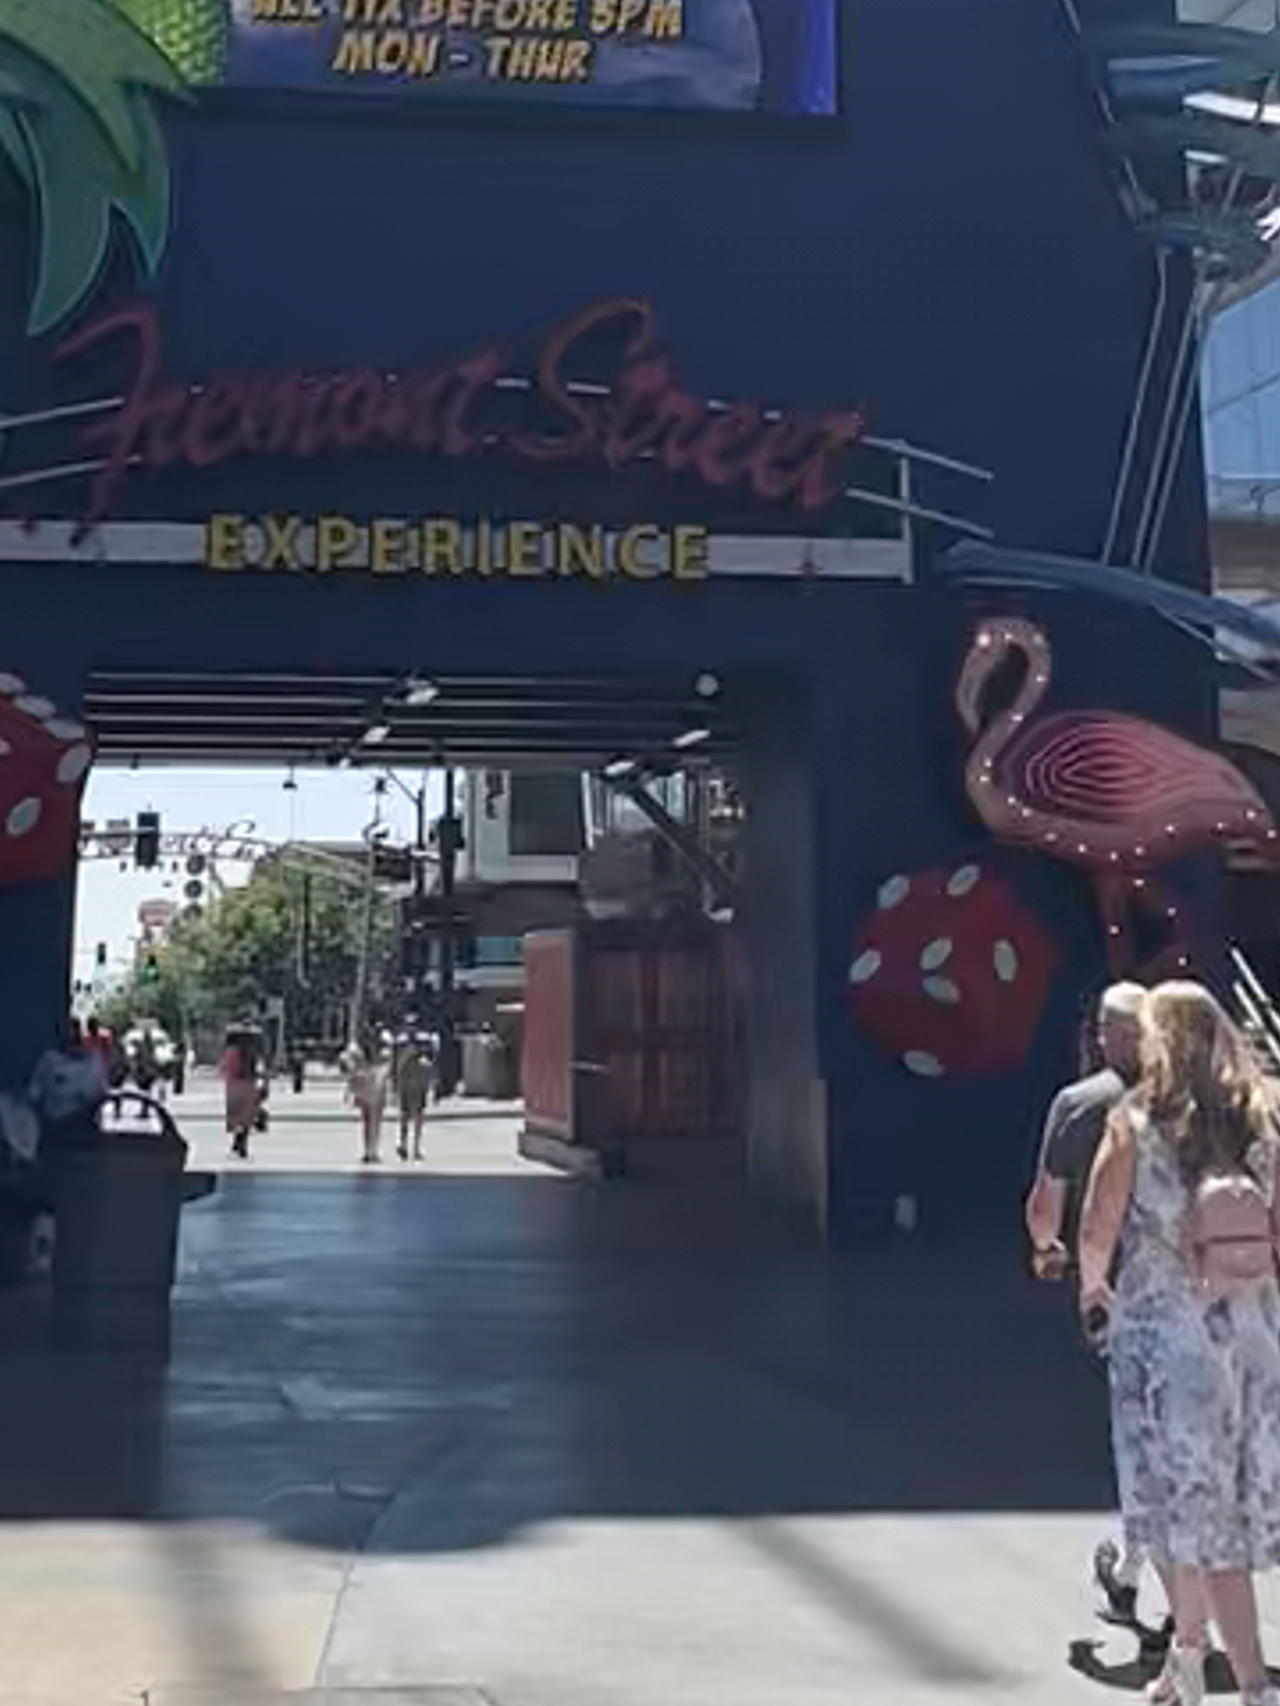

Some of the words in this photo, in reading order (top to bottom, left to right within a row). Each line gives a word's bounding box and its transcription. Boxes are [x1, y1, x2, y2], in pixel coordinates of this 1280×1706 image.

[331, 30, 440, 77] MON
[487, 35, 594, 82] THUR
[52, 302, 505, 544] Fremont
[512, 296, 870, 510] Street
[205, 510, 712, 580] EXPERIENCE
